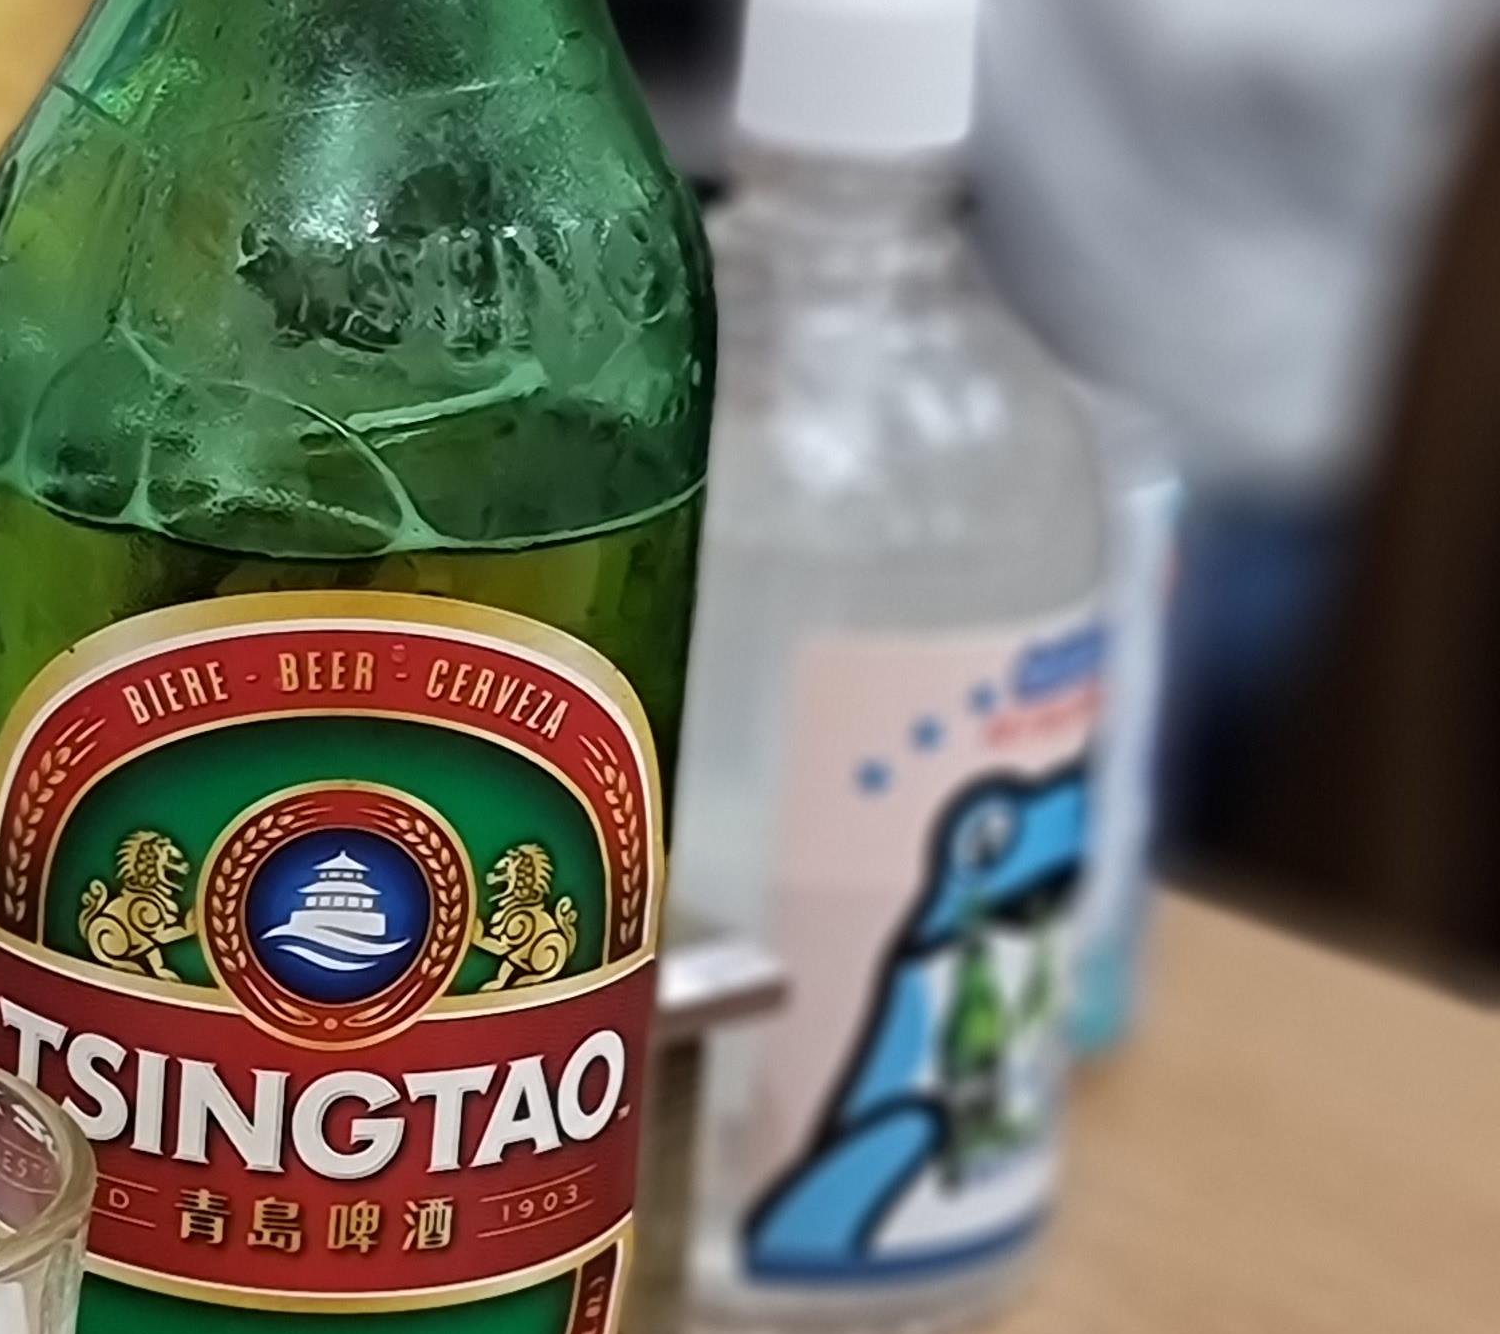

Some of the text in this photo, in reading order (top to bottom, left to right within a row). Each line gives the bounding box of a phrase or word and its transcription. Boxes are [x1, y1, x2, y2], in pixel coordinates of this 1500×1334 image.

[122, 651, 570, 740] BIERE BEER CERVEZA
[174, 1187, 455, 1254] 青島啤酒
[502, 1183, 579, 1222] 1903
